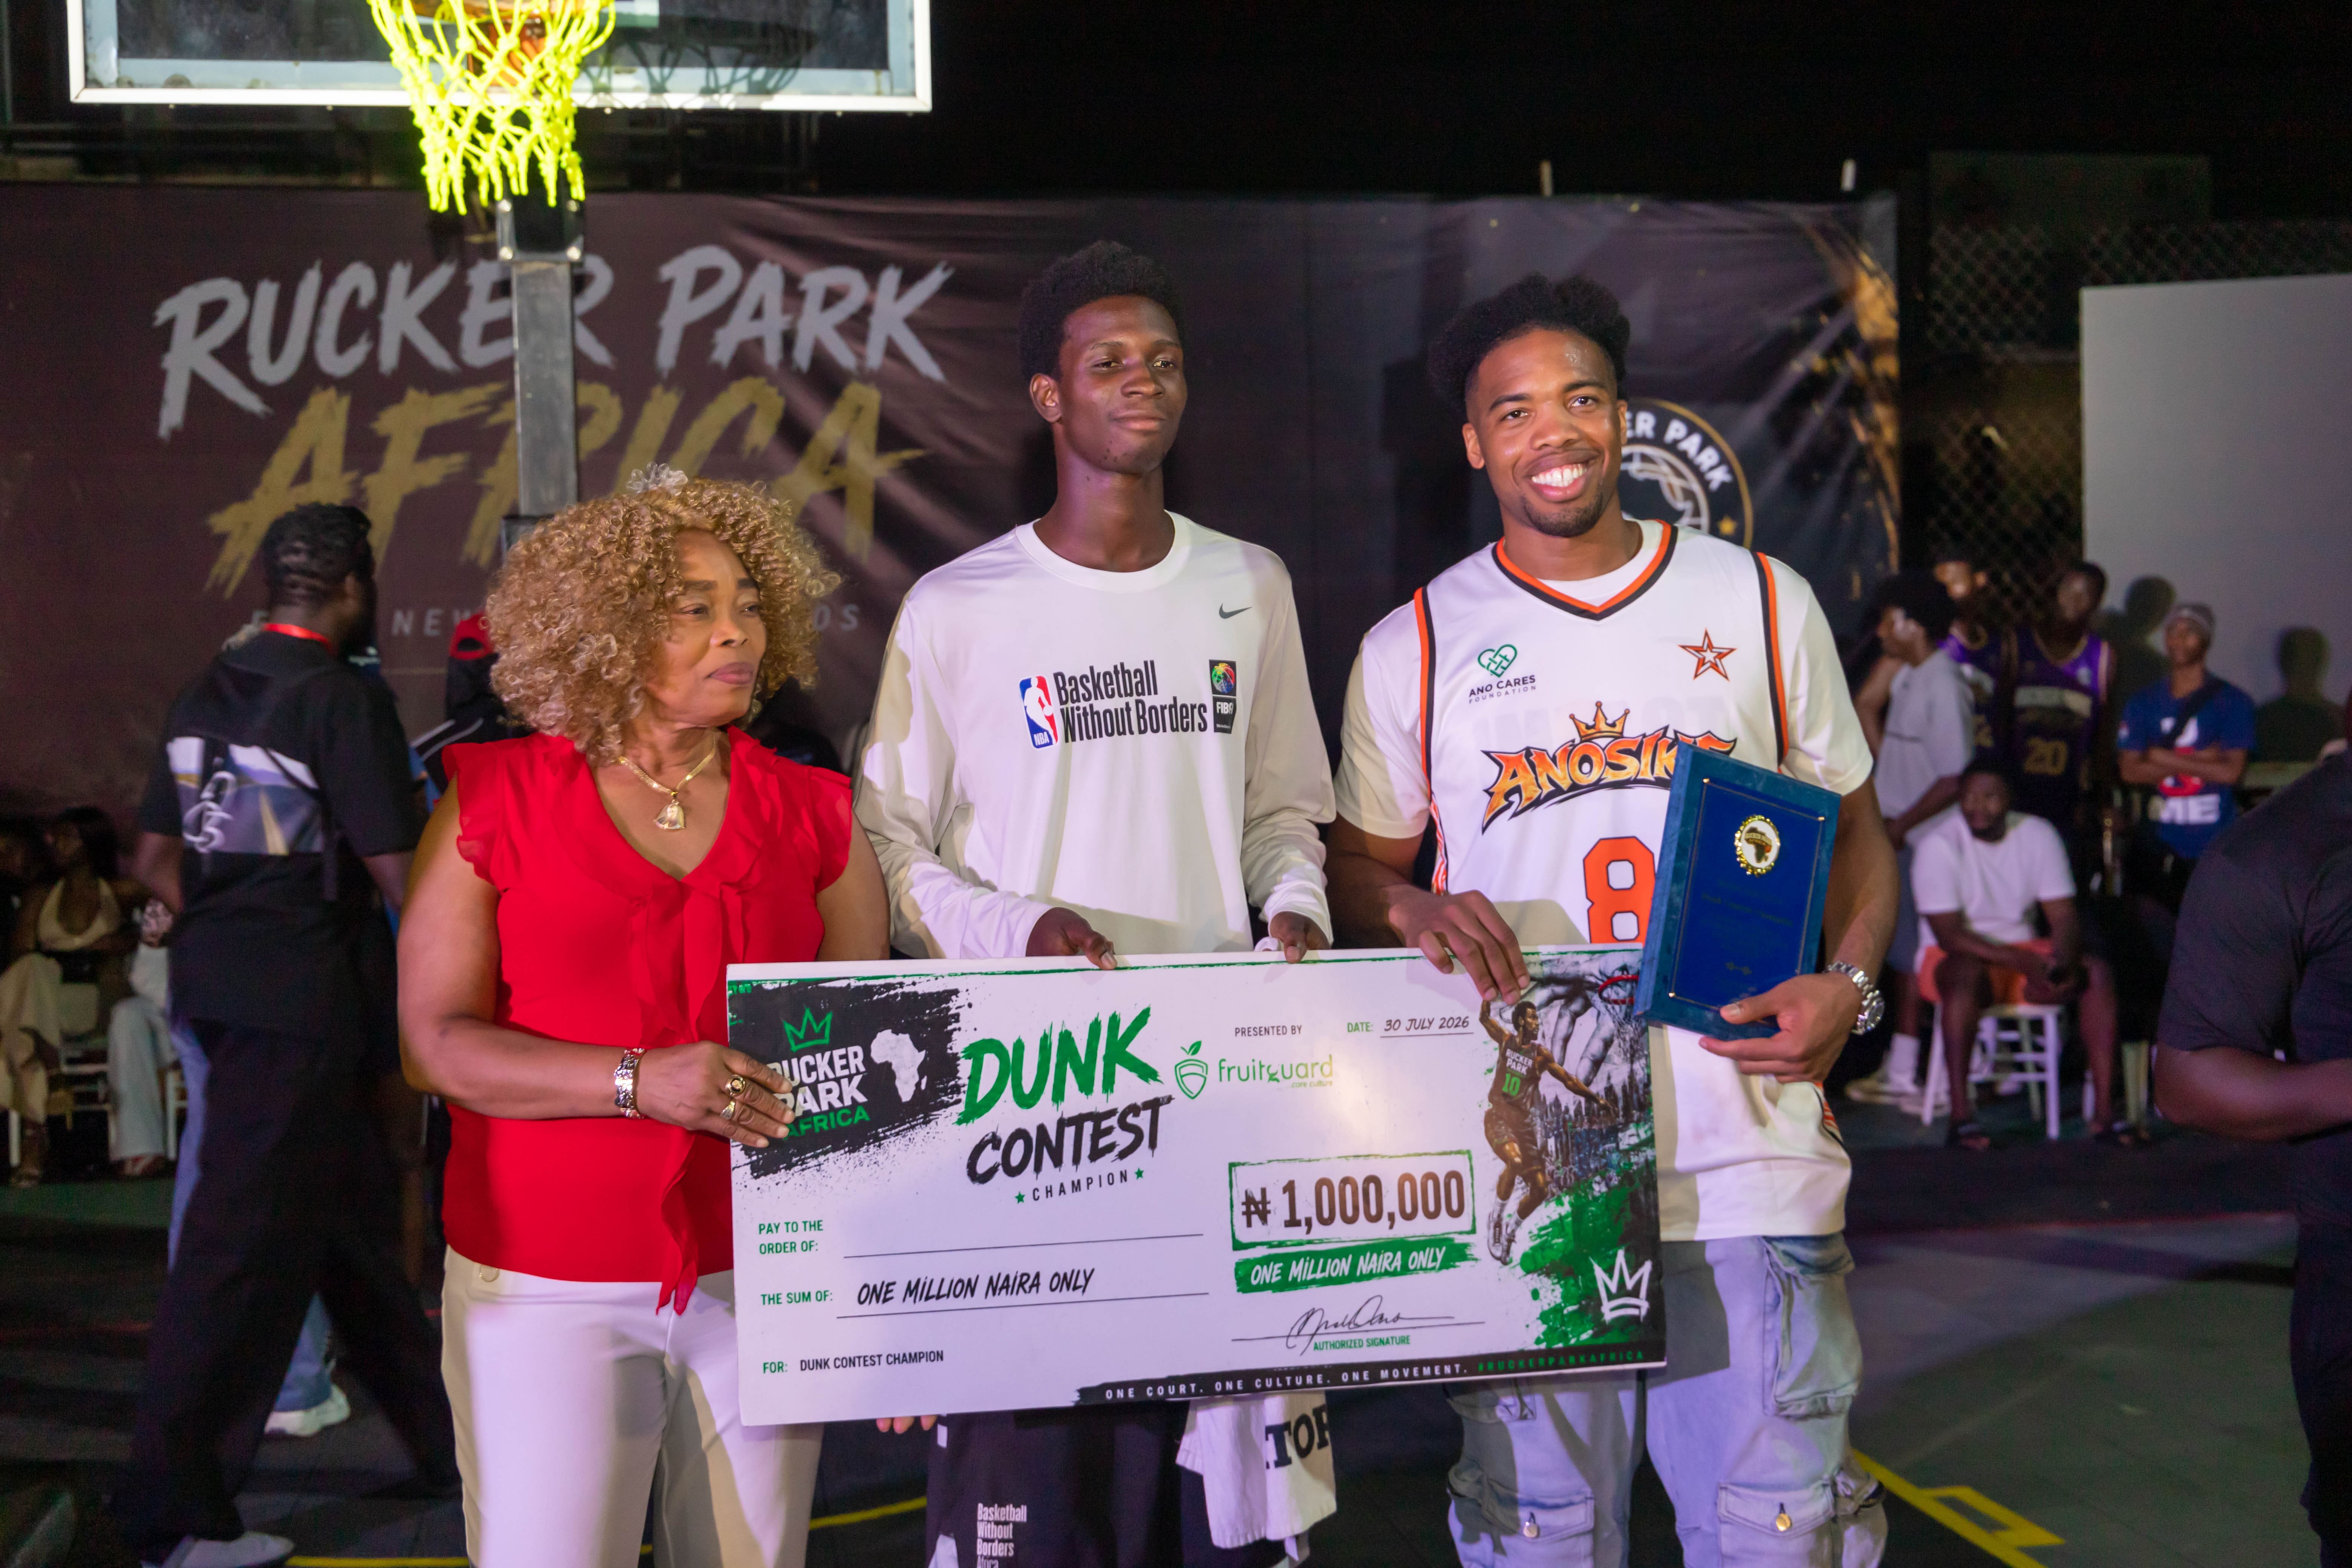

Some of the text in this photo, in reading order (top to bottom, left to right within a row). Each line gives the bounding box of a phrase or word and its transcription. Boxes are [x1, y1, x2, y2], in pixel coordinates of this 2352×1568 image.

[657, 245, 956, 381] PARK
[1663, 419, 1733, 492] PARK
[1053, 660, 1158, 706] Basketball
[1469, 675, 1536, 697] ANO CARES
[1469, 685, 1536, 704] FOUNDATION
[1216, 701, 1234, 715] FIBA
[1060, 696, 1208, 743] Without Borders
[1034, 731, 1050, 746] NBA
[1235, 1025, 1302, 1037] PRESENTED BY
[1347, 1016, 1469, 1033] DATE: 30 JULY 2026
[953, 1004, 1164, 1126] DUNK
[1505, 1049, 1533, 1068] RUCKER
[1507, 1058, 1528, 1075] PARK
[1502, 1073, 1521, 1096] 10
[782, 1105, 870, 1140] AFRICA
[966, 1094, 1174, 1185] CONTEST
[1032, 1171, 1128, 1201] CHAMPION
[1282, 1170, 1465, 1234] 1,000,000
[758, 1220, 824, 1235] PAY TO THE
[759, 1240, 818, 1255] ORDER OF:
[1251, 1246, 1446, 1285] ONE MILLION NAIRA ONLY
[761, 1268, 1095, 1306] THE SUM OF: ONE MILLION NAIRA ONLY
[1313, 1335, 1411, 1351] AUTHORIZED SIGNATURE
[763, 1350, 945, 1374] FOR: DUNK CONTEST CHAMPION
[1106, 1387, 1135, 1400] ONE
[1147, 1382, 1204, 1397] COURT.
[1215, 1380, 1243, 1392] ONE
[1255, 1374, 1330, 1389] CULTURE.
[1341, 1370, 1370, 1383] ONE
[1380, 1363, 1467, 1380] MOVEMENT.
[977, 1502, 1027, 1522] Basketball
[977, 1521, 1014, 1539] Without
[977, 1537, 1015, 1557] Borders
